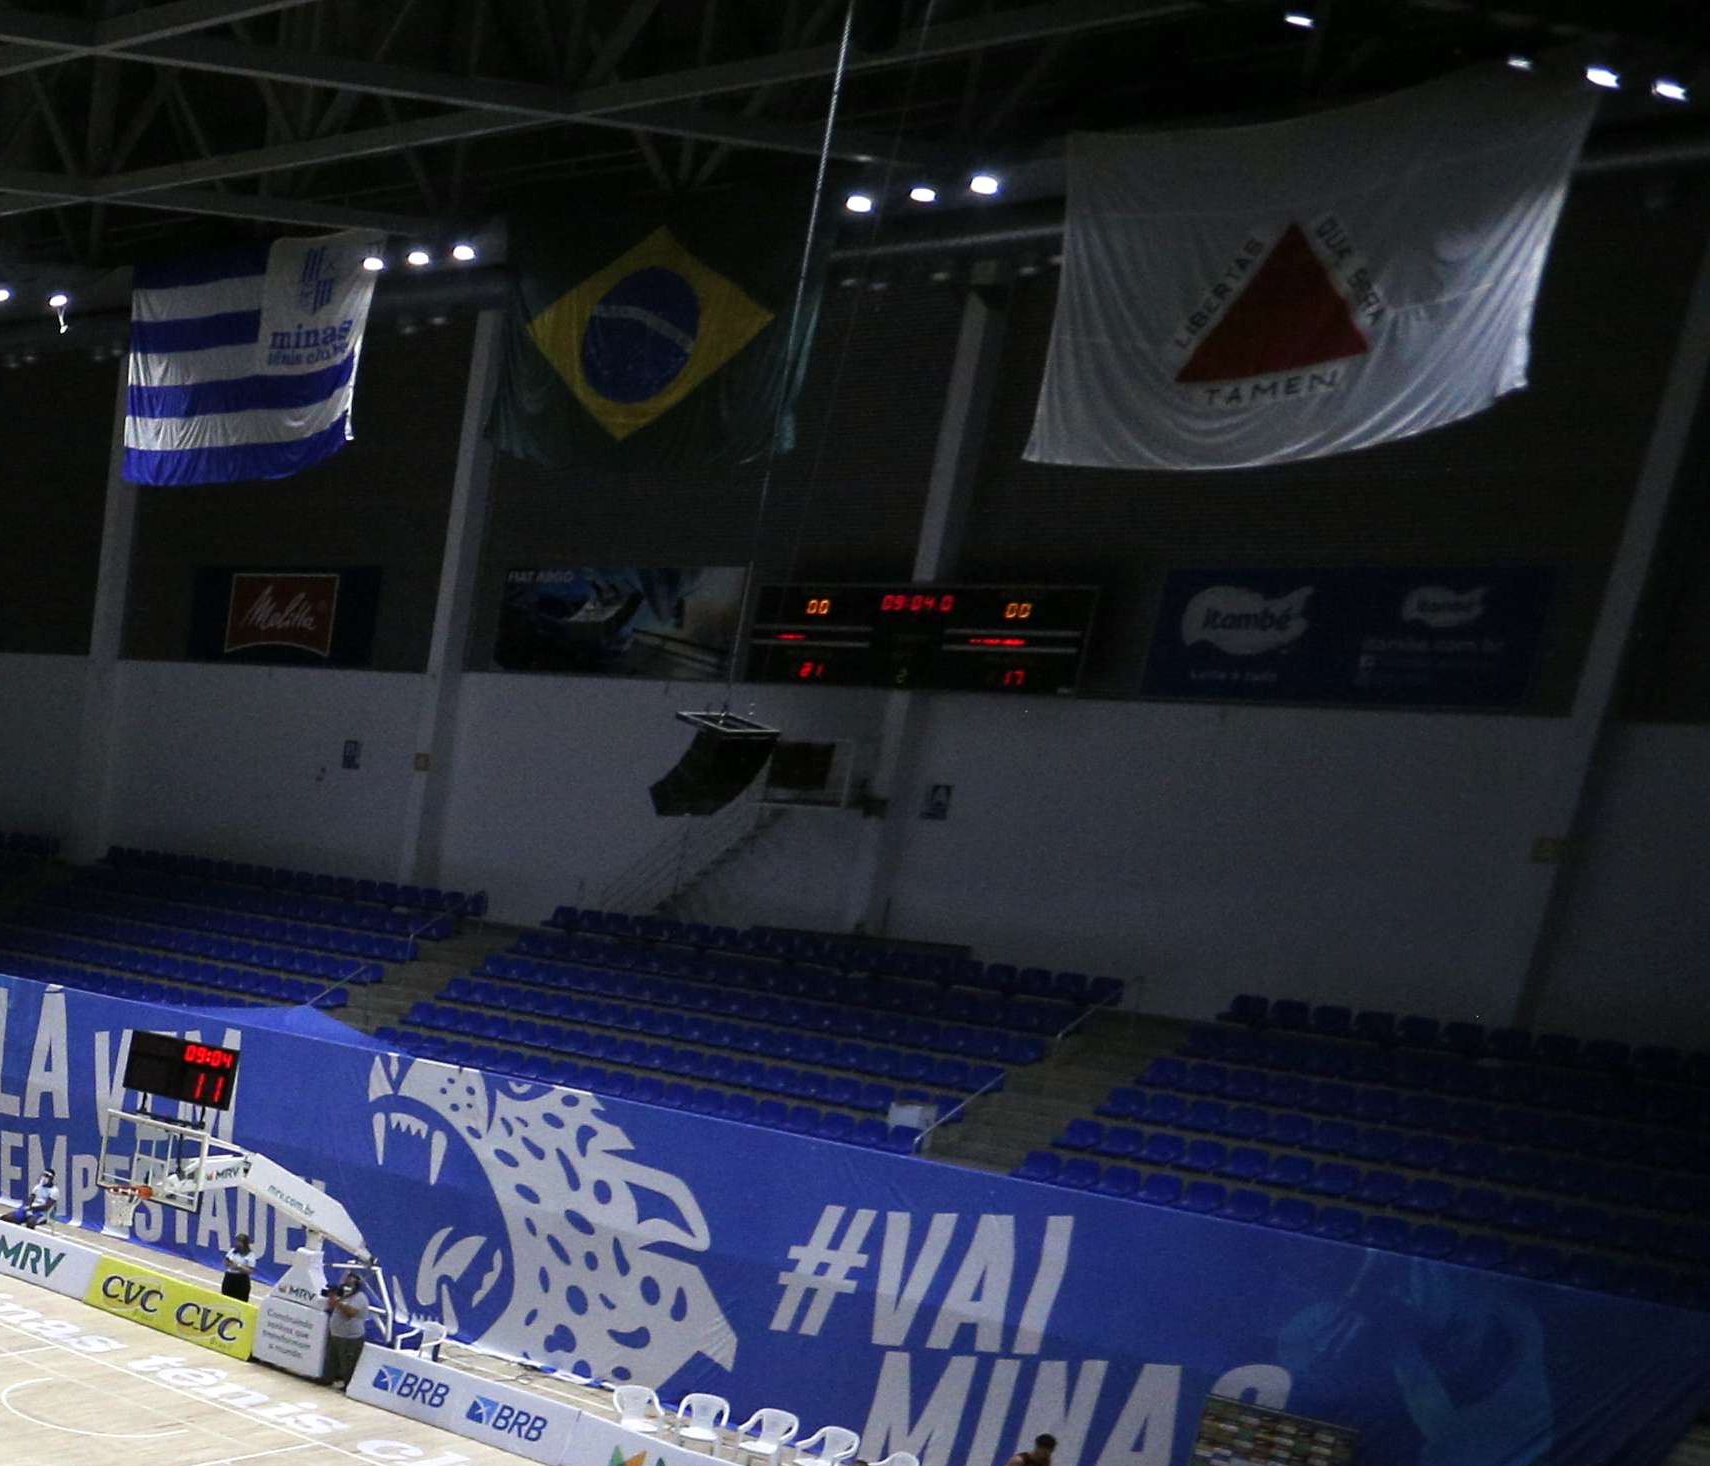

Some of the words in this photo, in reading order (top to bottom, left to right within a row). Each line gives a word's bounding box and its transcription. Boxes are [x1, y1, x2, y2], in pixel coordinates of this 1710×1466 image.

[270, 320, 353, 349] minas
[1204, 370, 1338, 406] TAMEN
[1203, 608, 1292, 632] itambé
[183, 1044, 234, 1069] 09:04
[194, 1072, 225, 1102] 11
[216, 1167, 240, 1181] MRV
[267, 1185, 316, 1218] mrv.com.br
[102, 1275, 164, 1313] CVC
[289, 1285, 316, 1301] MRV
[769, 1205, 1076, 1355] #VAI
[176, 1302, 244, 1342] CVC
[128, 1350, 351, 1436] tênis
[396, 1375, 451, 1410] BRB
[491, 1407, 549, 1443] BRB
